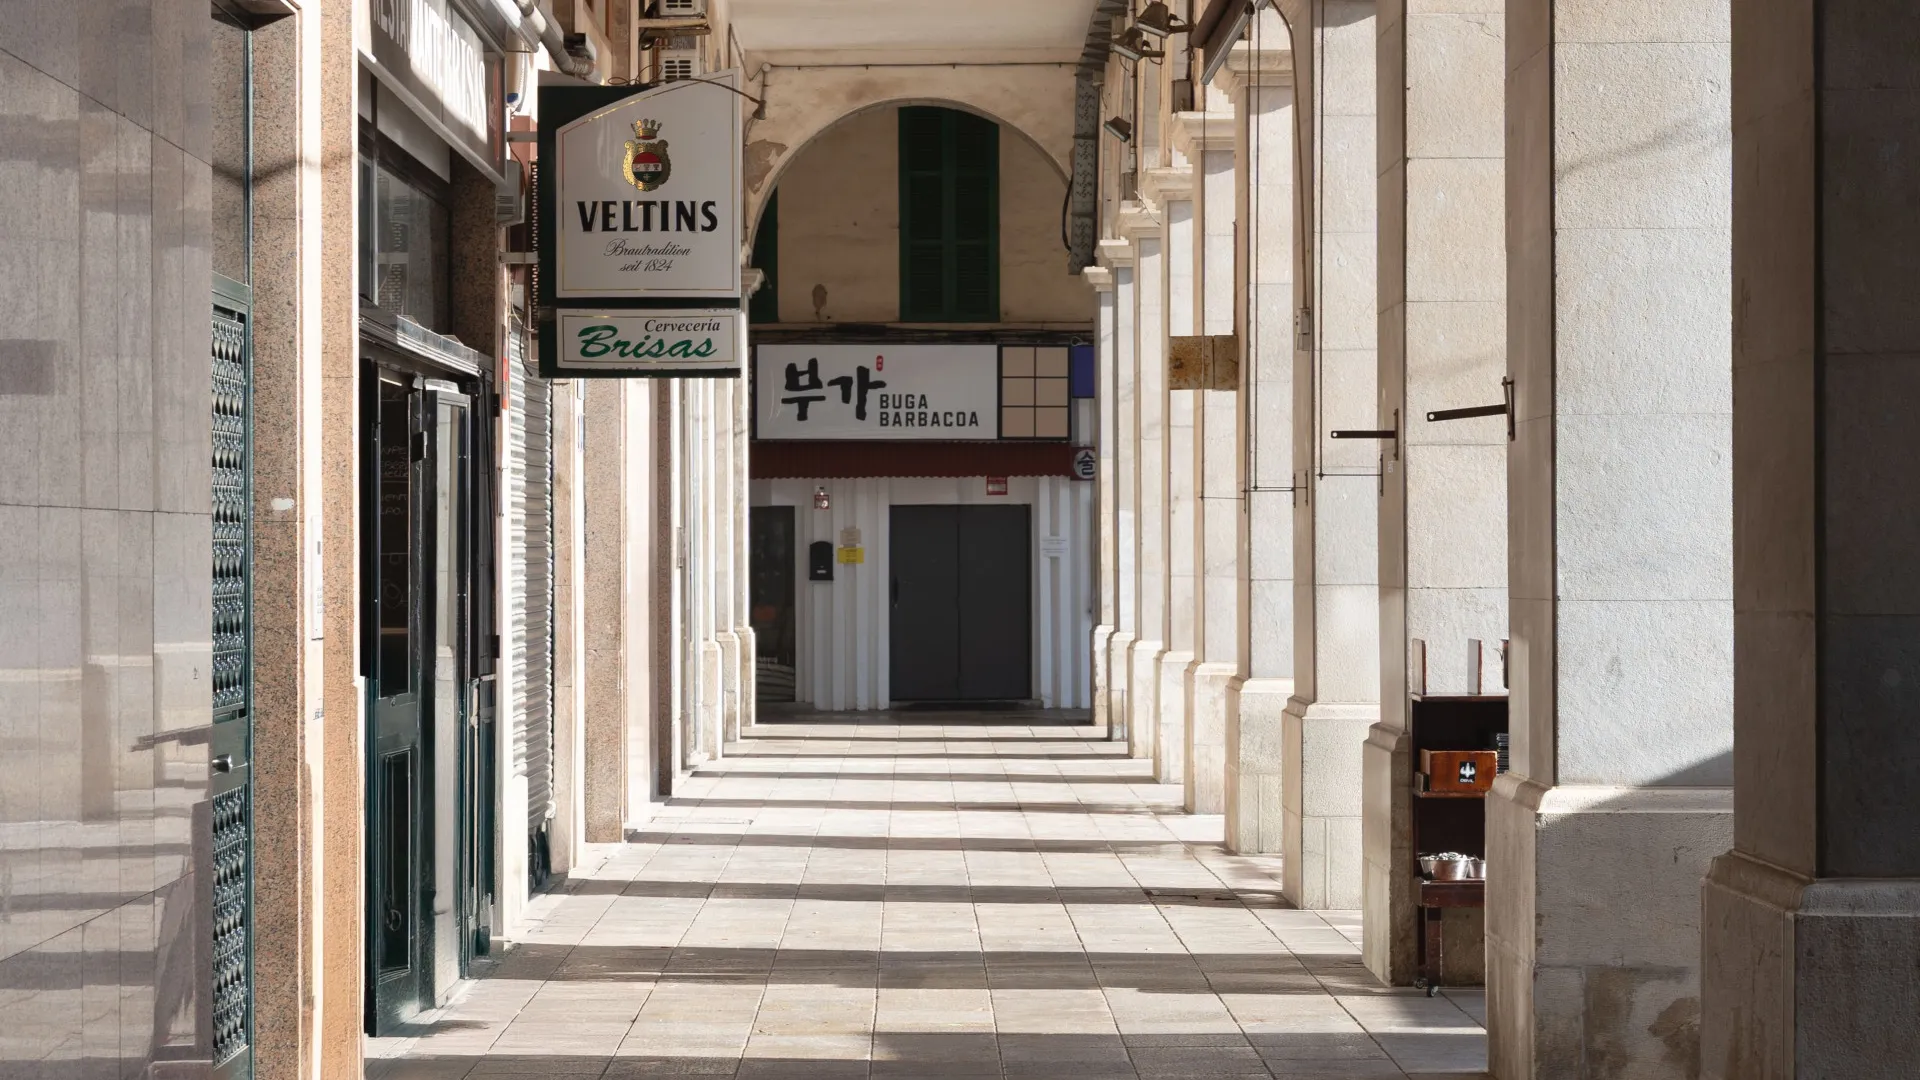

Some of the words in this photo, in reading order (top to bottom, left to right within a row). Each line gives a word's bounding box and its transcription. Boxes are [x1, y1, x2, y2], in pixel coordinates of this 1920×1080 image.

[577, 200, 718, 233] VELTINS
[603, 238, 691, 257] Brautradition
[620, 260, 642, 272] seit
[644, 259, 674, 272] 1824
[644, 319, 721, 332] Cervecería
[578, 325, 718, 359] Brisas
[781, 357, 887, 422] 부가
[879, 394, 929, 410] BUGA
[879, 411, 979, 427] BARBACOA
